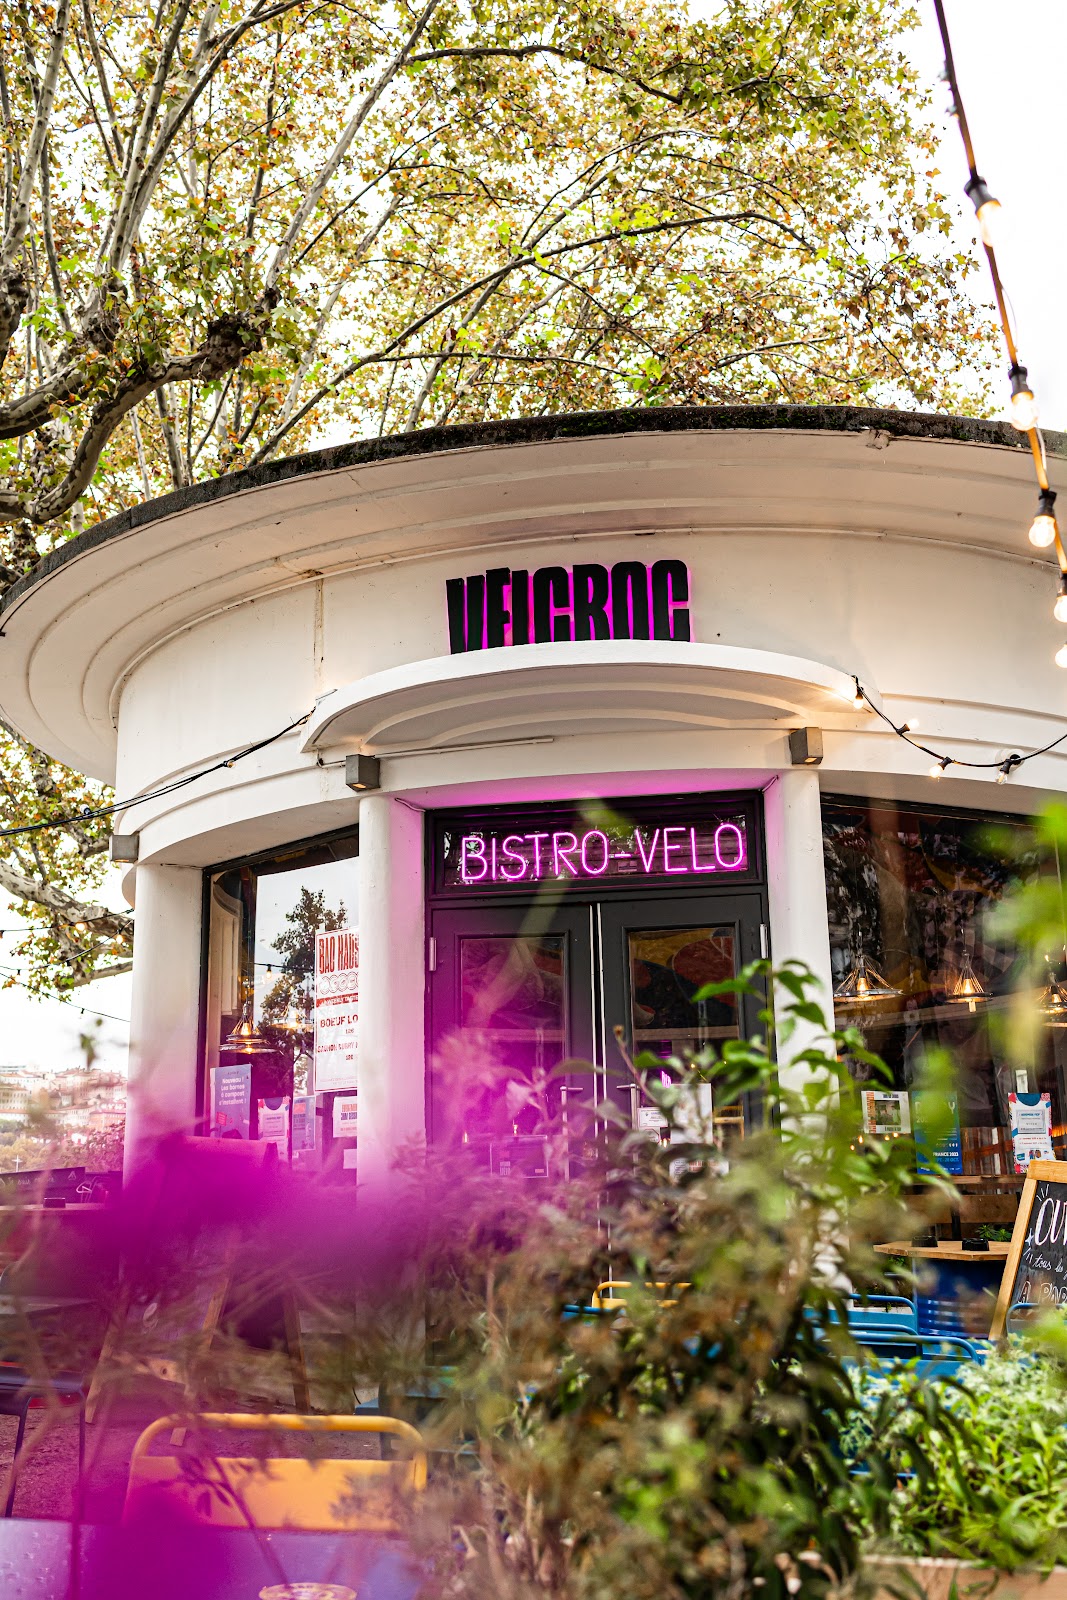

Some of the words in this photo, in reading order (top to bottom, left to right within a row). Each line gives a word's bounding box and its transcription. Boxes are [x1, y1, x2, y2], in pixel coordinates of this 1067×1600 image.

[319, 936, 335, 975] BAO
[320, 1015, 346, 1028] BOEUF
[1034, 1197, 1067, 1247] OU
